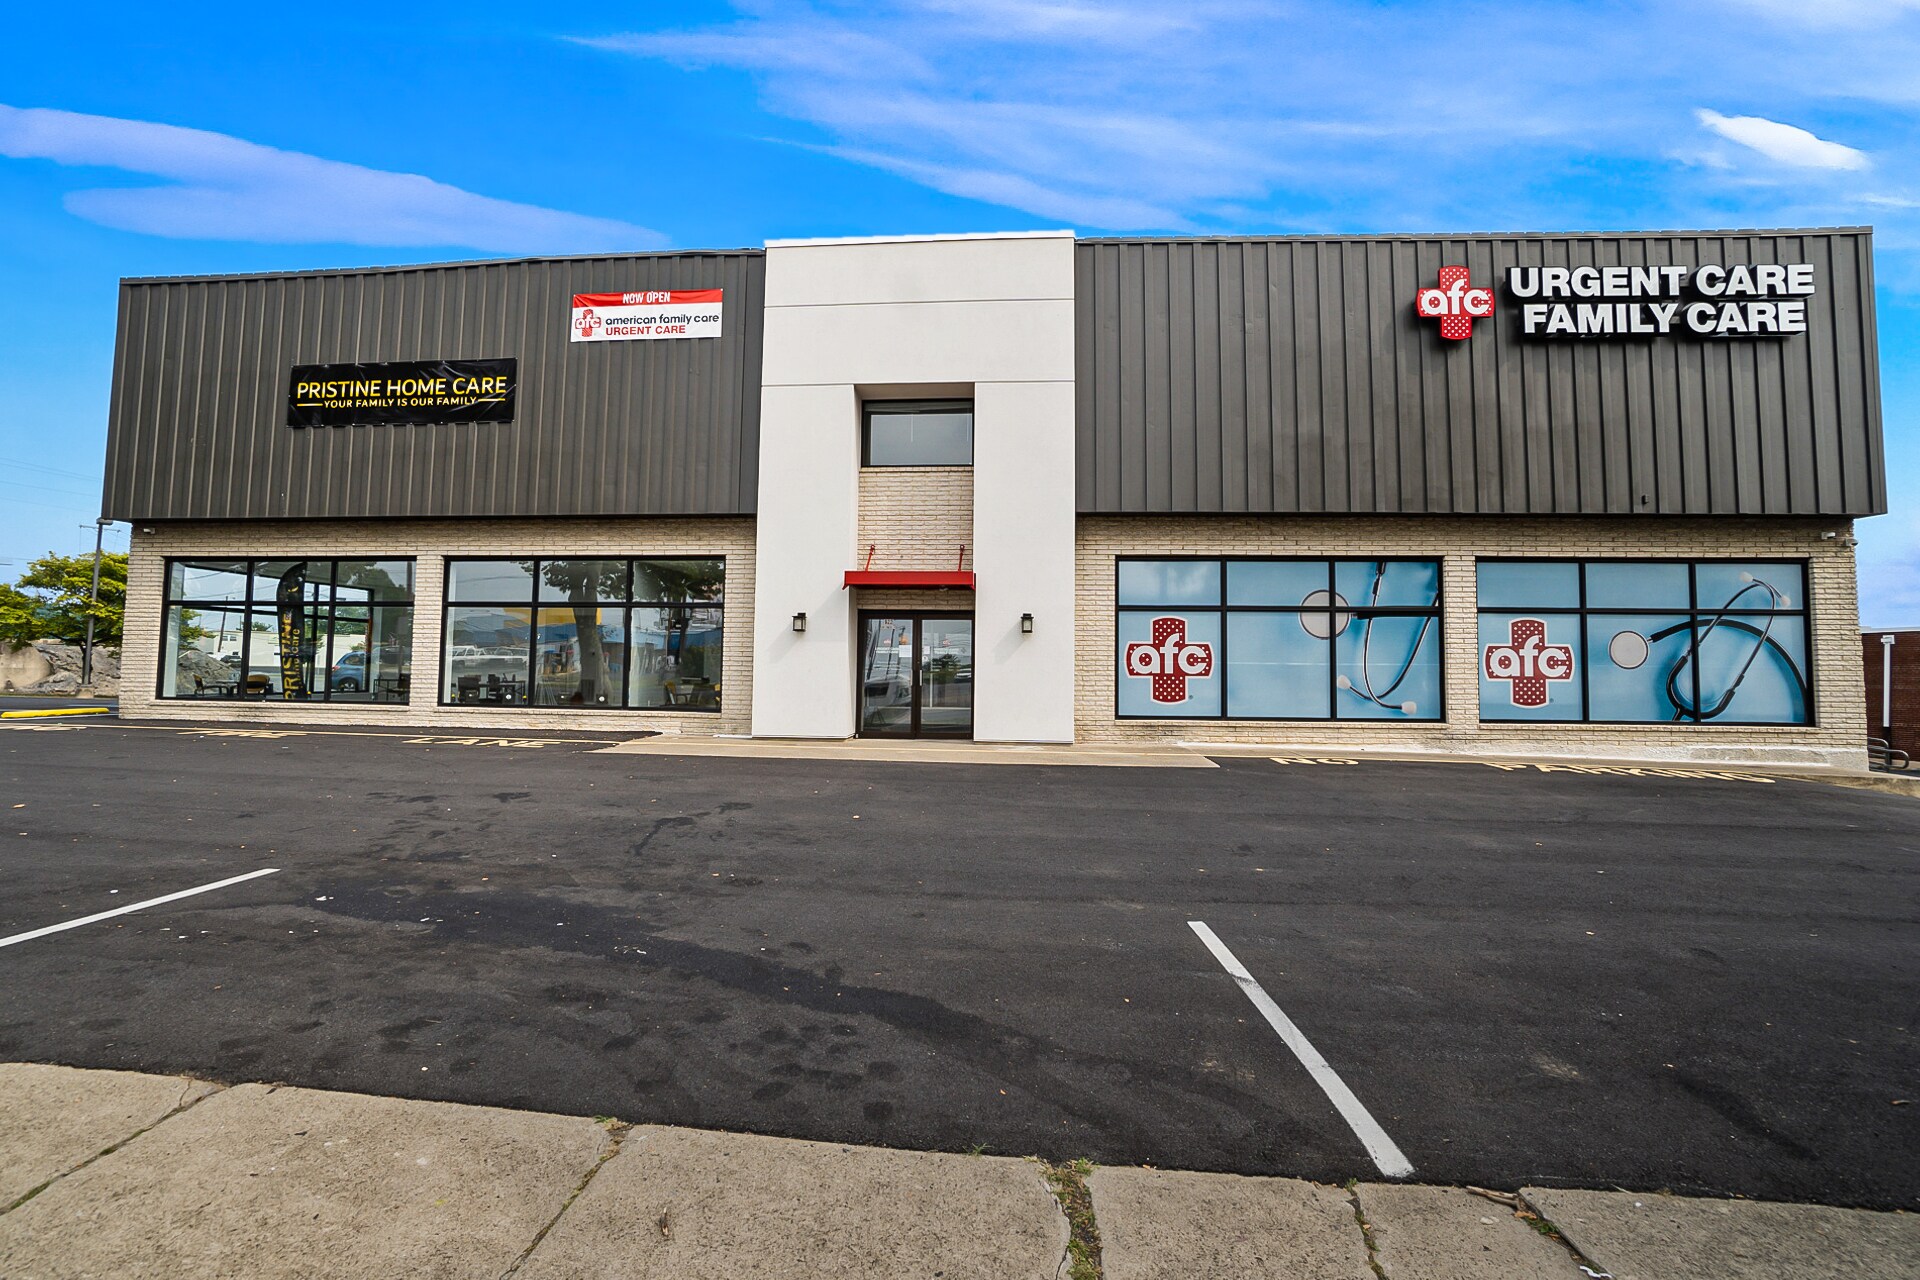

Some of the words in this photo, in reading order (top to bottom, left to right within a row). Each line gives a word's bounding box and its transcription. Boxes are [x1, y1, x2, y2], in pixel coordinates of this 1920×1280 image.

[1510, 265, 1687, 297] URGENT
[1696, 264, 1816, 296] CARE
[622, 293, 645, 304] NOW
[646, 291, 671, 303] OPEN
[1421, 278, 1490, 315] afc
[576, 312, 601, 329] afc
[605, 315, 657, 325] american
[659, 313, 692, 325] family
[693, 314, 720, 323] care
[1523, 303, 1679, 333] FAMILY
[1686, 302, 1807, 332] CARE
[605, 326, 652, 336] URGENT
[655, 325, 686, 335] CARE
[297, 380, 382, 399] PRISTINE
[386, 378, 447, 396] HOME
[452, 376, 508, 395] CARE
[324, 399, 353, 409] YOUR
[355, 398, 394, 408] FAMILY
[397, 398, 408, 407] IS
[410, 397, 434, 407] OUR
[436, 396, 477, 406] FAMILY
[1130, 632, 1208, 675] afc
[1489, 633, 1568, 678] afc
[402, 737, 561, 748] LANE
[1269, 757, 1359, 765] NO
